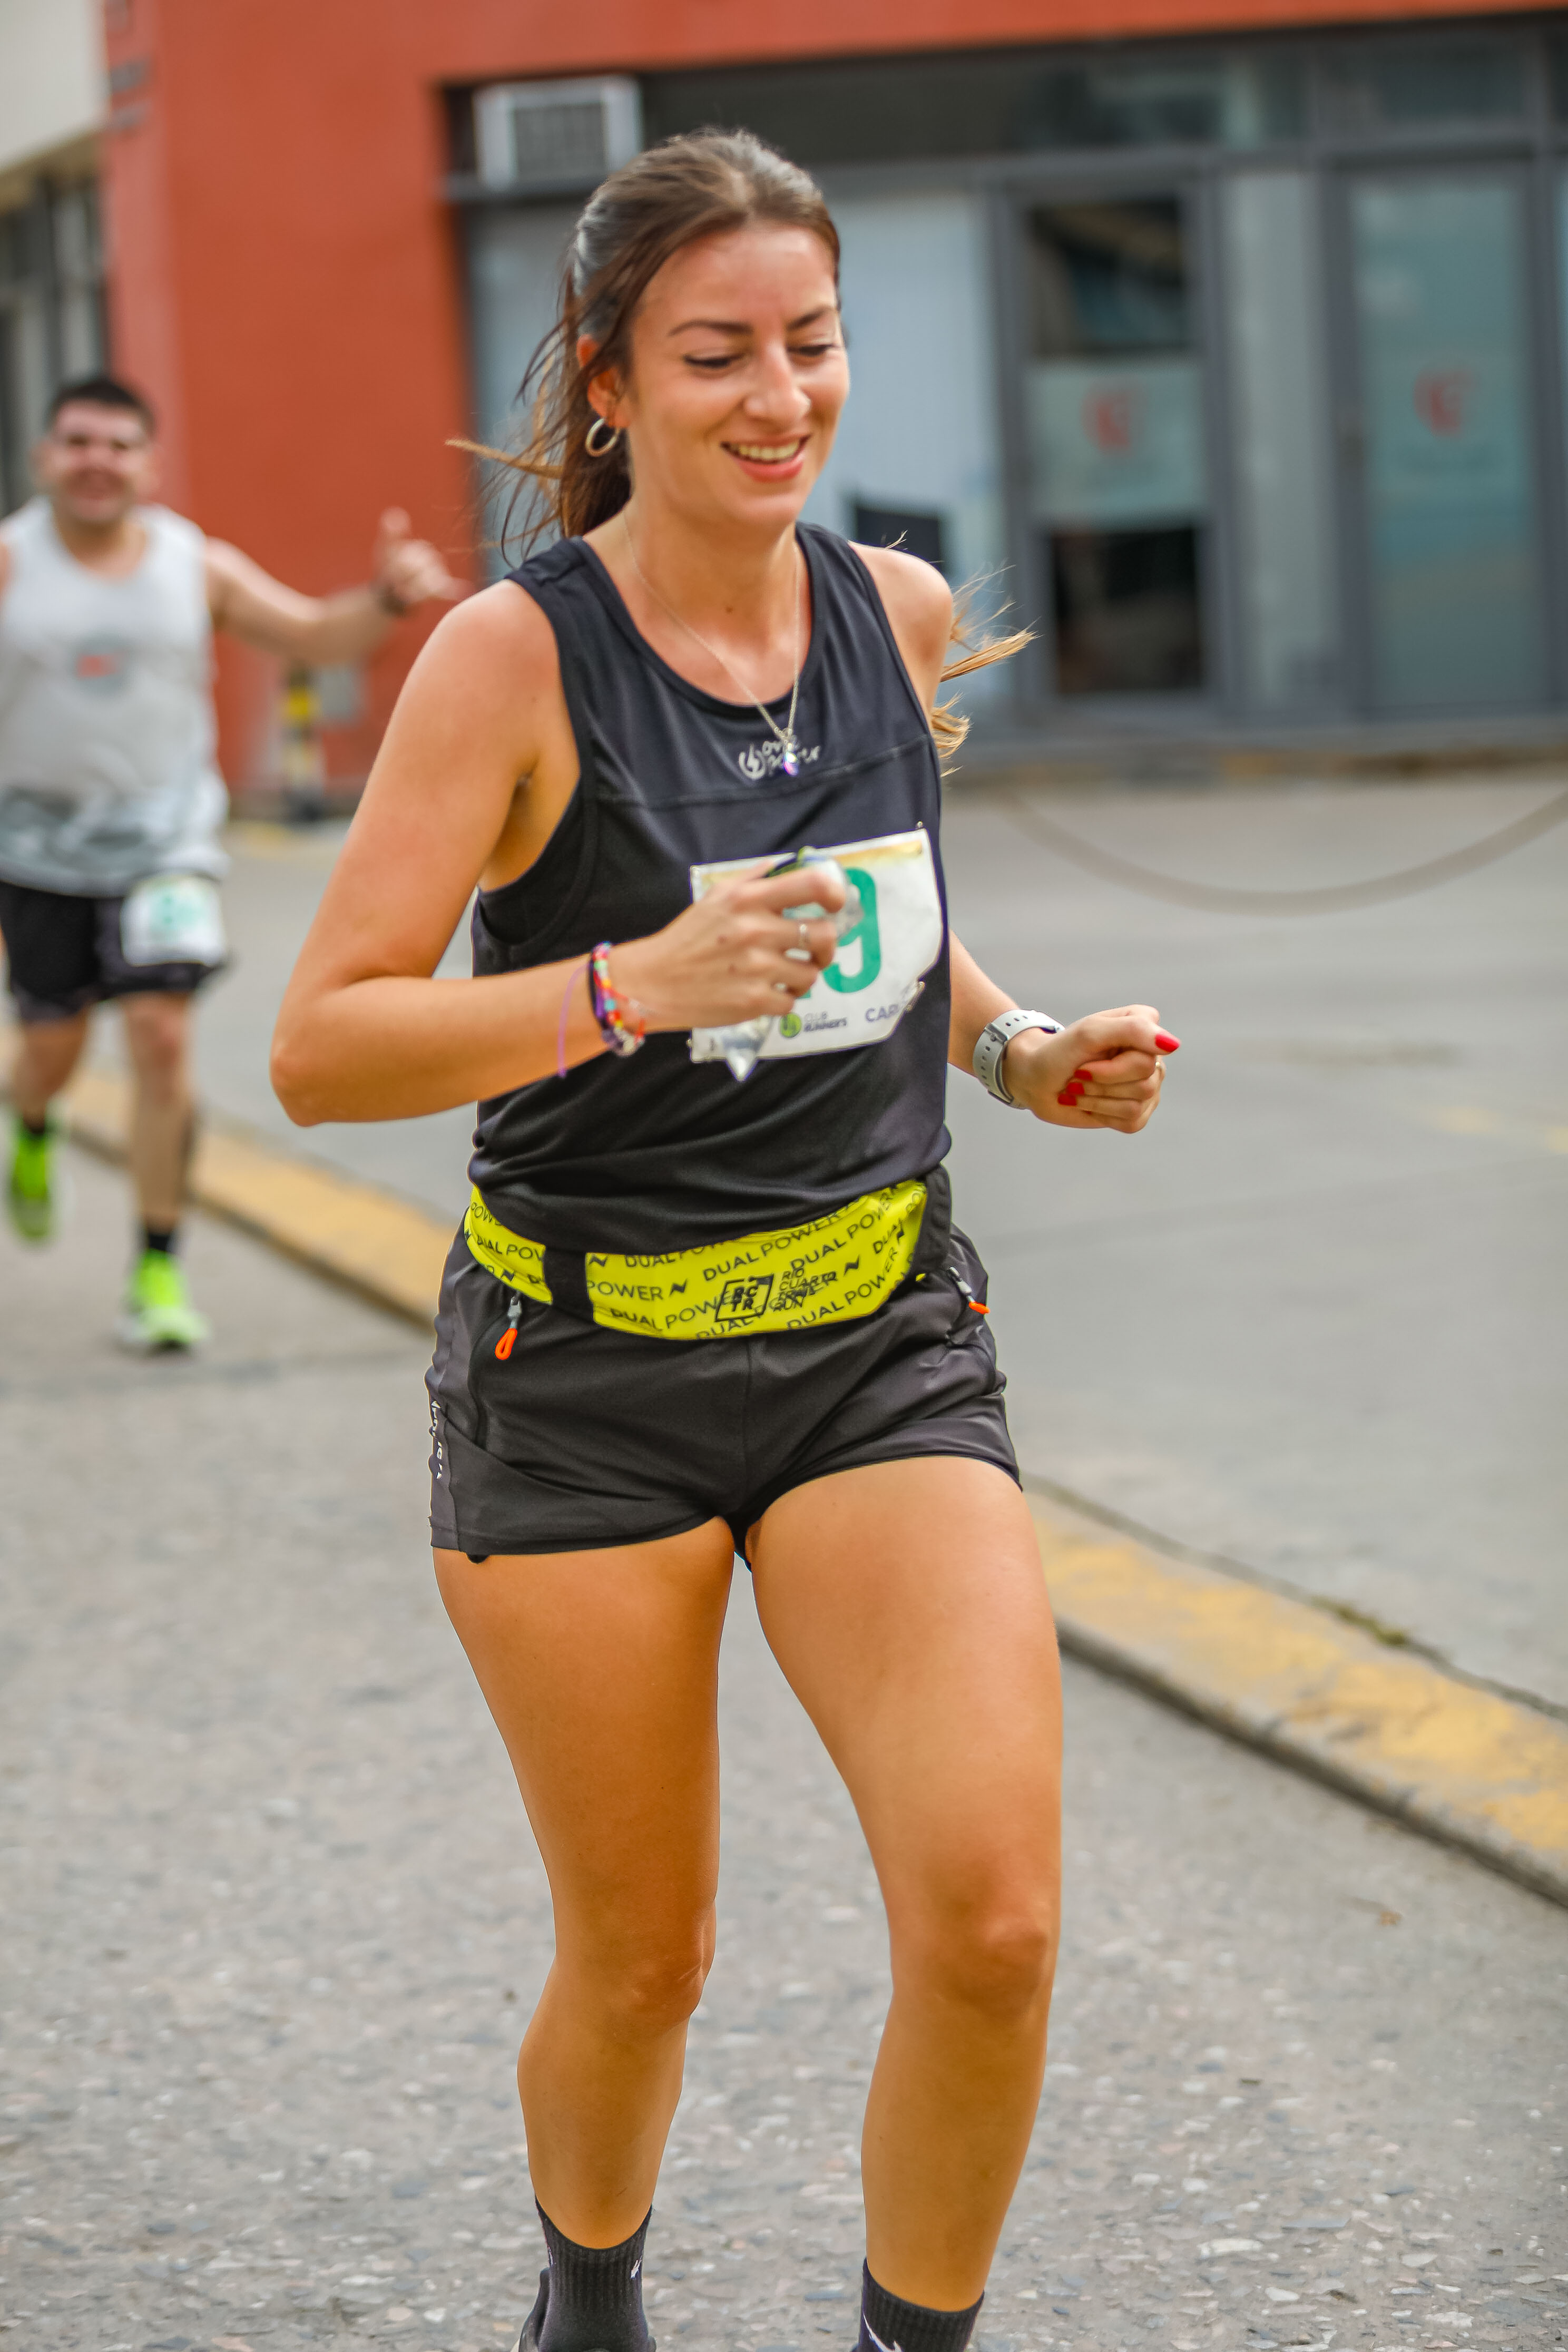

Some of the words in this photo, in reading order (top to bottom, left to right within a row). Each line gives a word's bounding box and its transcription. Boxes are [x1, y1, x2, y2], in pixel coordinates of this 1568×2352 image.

[703, 1252, 759, 1281] DUAL
[760, 1212, 839, 1257] POWER
[790, 1239, 847, 1272] DUAL
[586, 1280, 663, 1301] POWER
[787, 1300, 845, 1329] DUAL
[844, 1247, 898, 1305] POWER
[610, 1307, 663, 1331] DUAL
